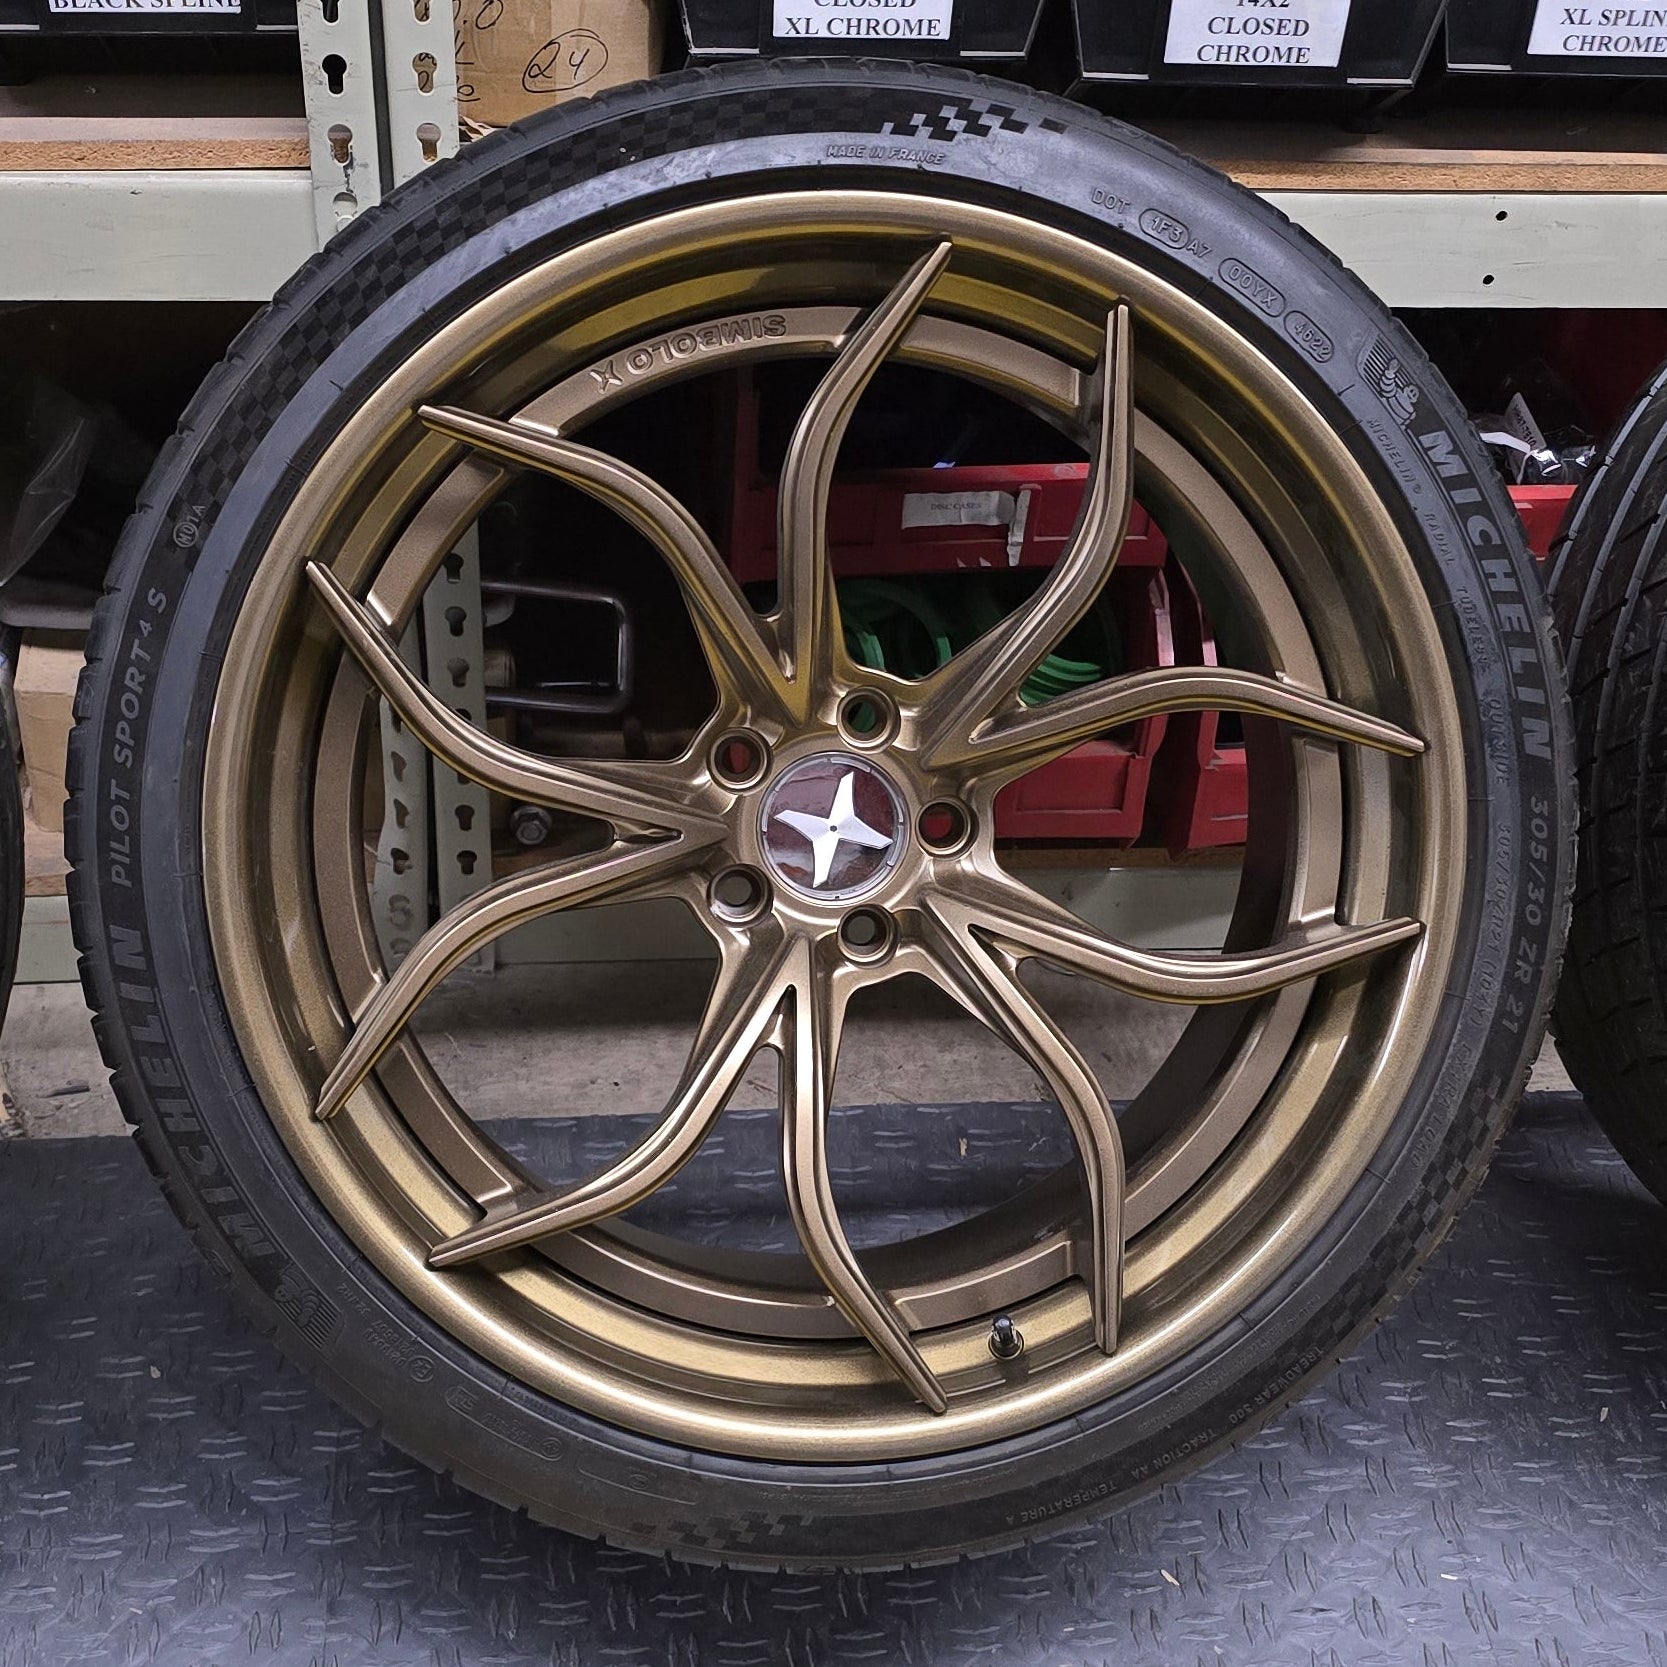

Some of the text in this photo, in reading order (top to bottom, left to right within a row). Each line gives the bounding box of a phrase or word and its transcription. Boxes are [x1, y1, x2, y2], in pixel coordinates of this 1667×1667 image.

[785, 17, 941, 37] XL CHROME
[1207, 16, 1310, 37] CLOSED
[1560, 8, 1667, 27] XL SPLIN
[528, 42, 590, 80] 24
[1196, 44, 1310, 64] CHROME
[1562, 34, 1667, 53] CHROME
[826, 144, 946, 166] MADE IN FRANCE
[1091, 187, 1131, 215] DOT
[1294, 318, 1333, 361] 4622
[626, 314, 787, 375] SIMBOLO
[1424, 513, 1456, 566] RADIAL
[147, 586, 168, 614] S
[113, 639, 151, 770] SPORT
[1418, 429, 1552, 1034] MICHELIN 305/30 ZR 21
[108, 778, 133, 888] PILOT
[109, 923, 278, 1259] MICHELIN
[1253, 1345, 1323, 1406] TREADWEAR
[1228, 1401, 1255, 1425] 300
[1152, 1427, 1219, 1471] TRACTION
[1131, 1466, 1150, 1482] AA
[1005, 1514, 1015, 1526] A
[1021, 1480, 1117, 1524] TEMPERATURE
